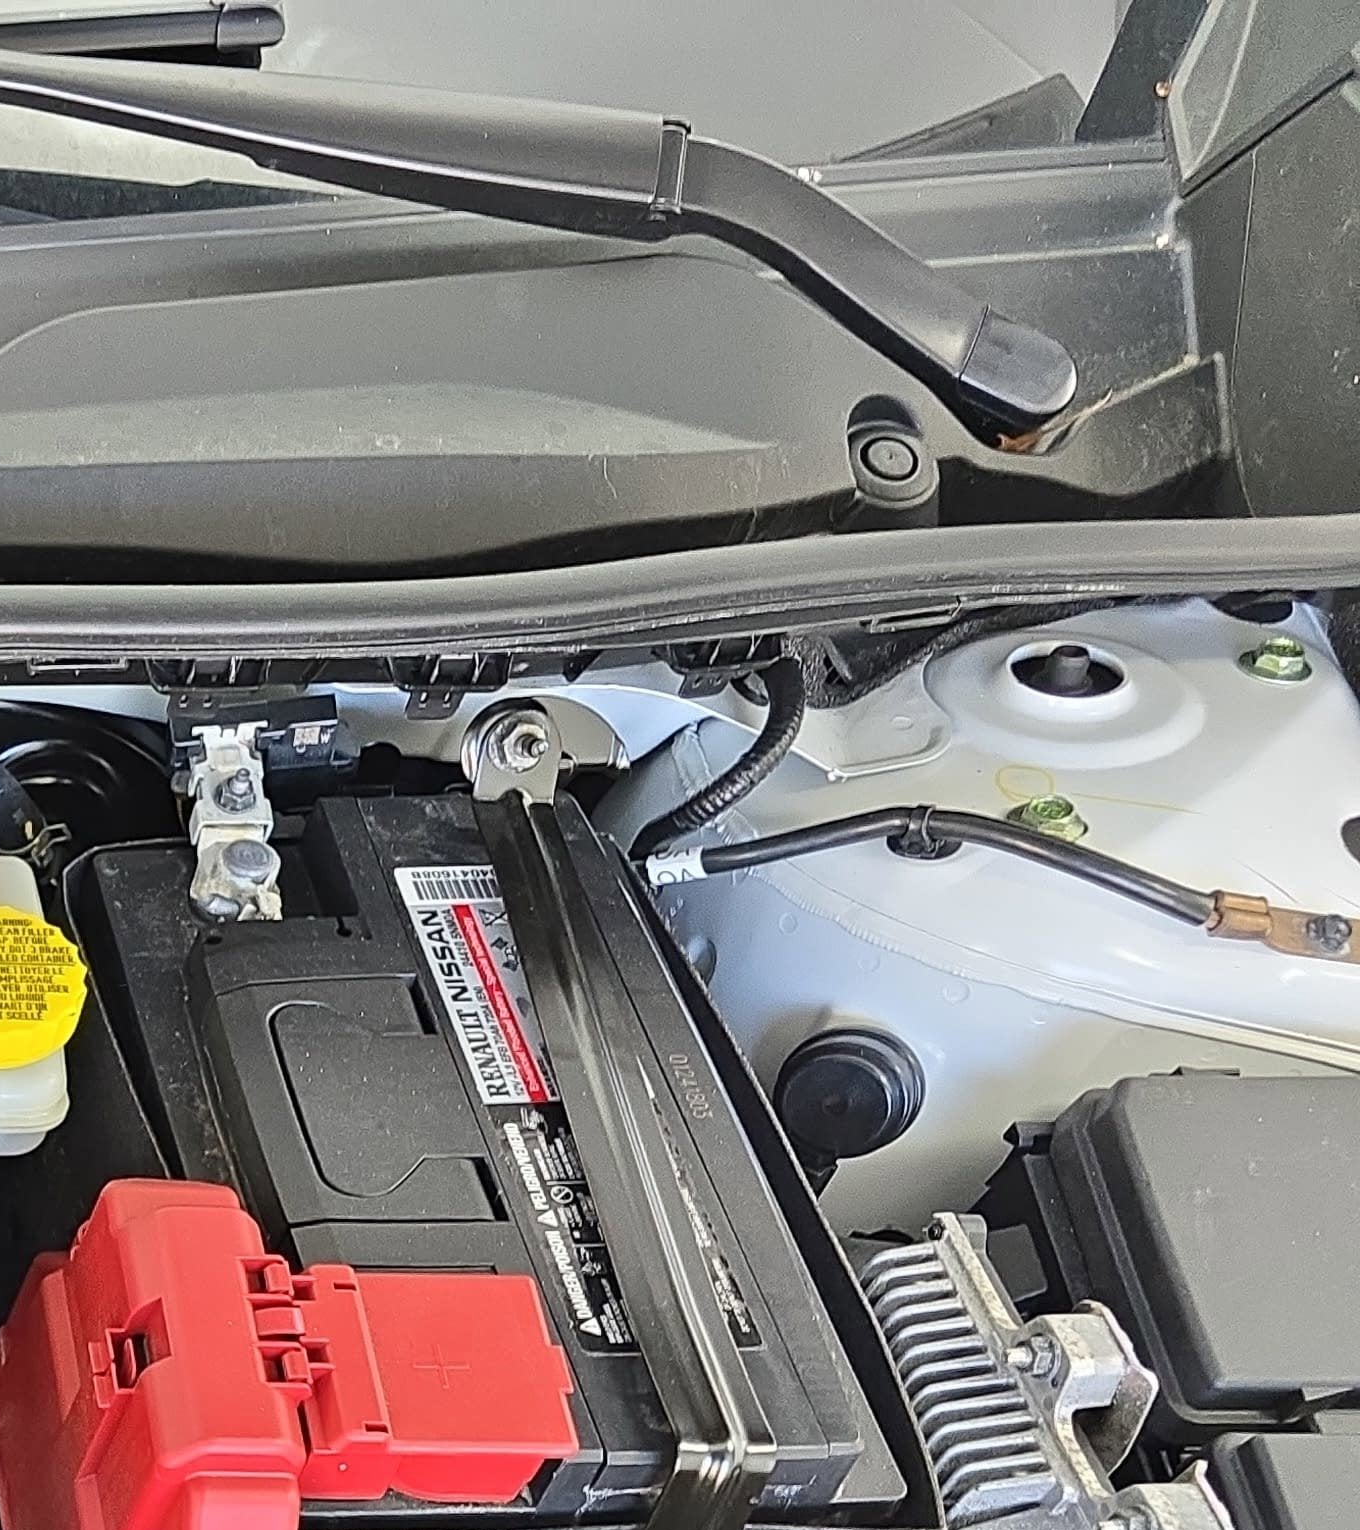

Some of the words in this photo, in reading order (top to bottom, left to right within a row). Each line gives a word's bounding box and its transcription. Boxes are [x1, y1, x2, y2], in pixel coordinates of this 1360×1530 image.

[13, 936, 48, 945] BEFORE
[38, 945, 71, 955] BRAKE
[416, 909, 474, 1003] NISSAN
[456, 1008, 511, 1099] RENAULT
